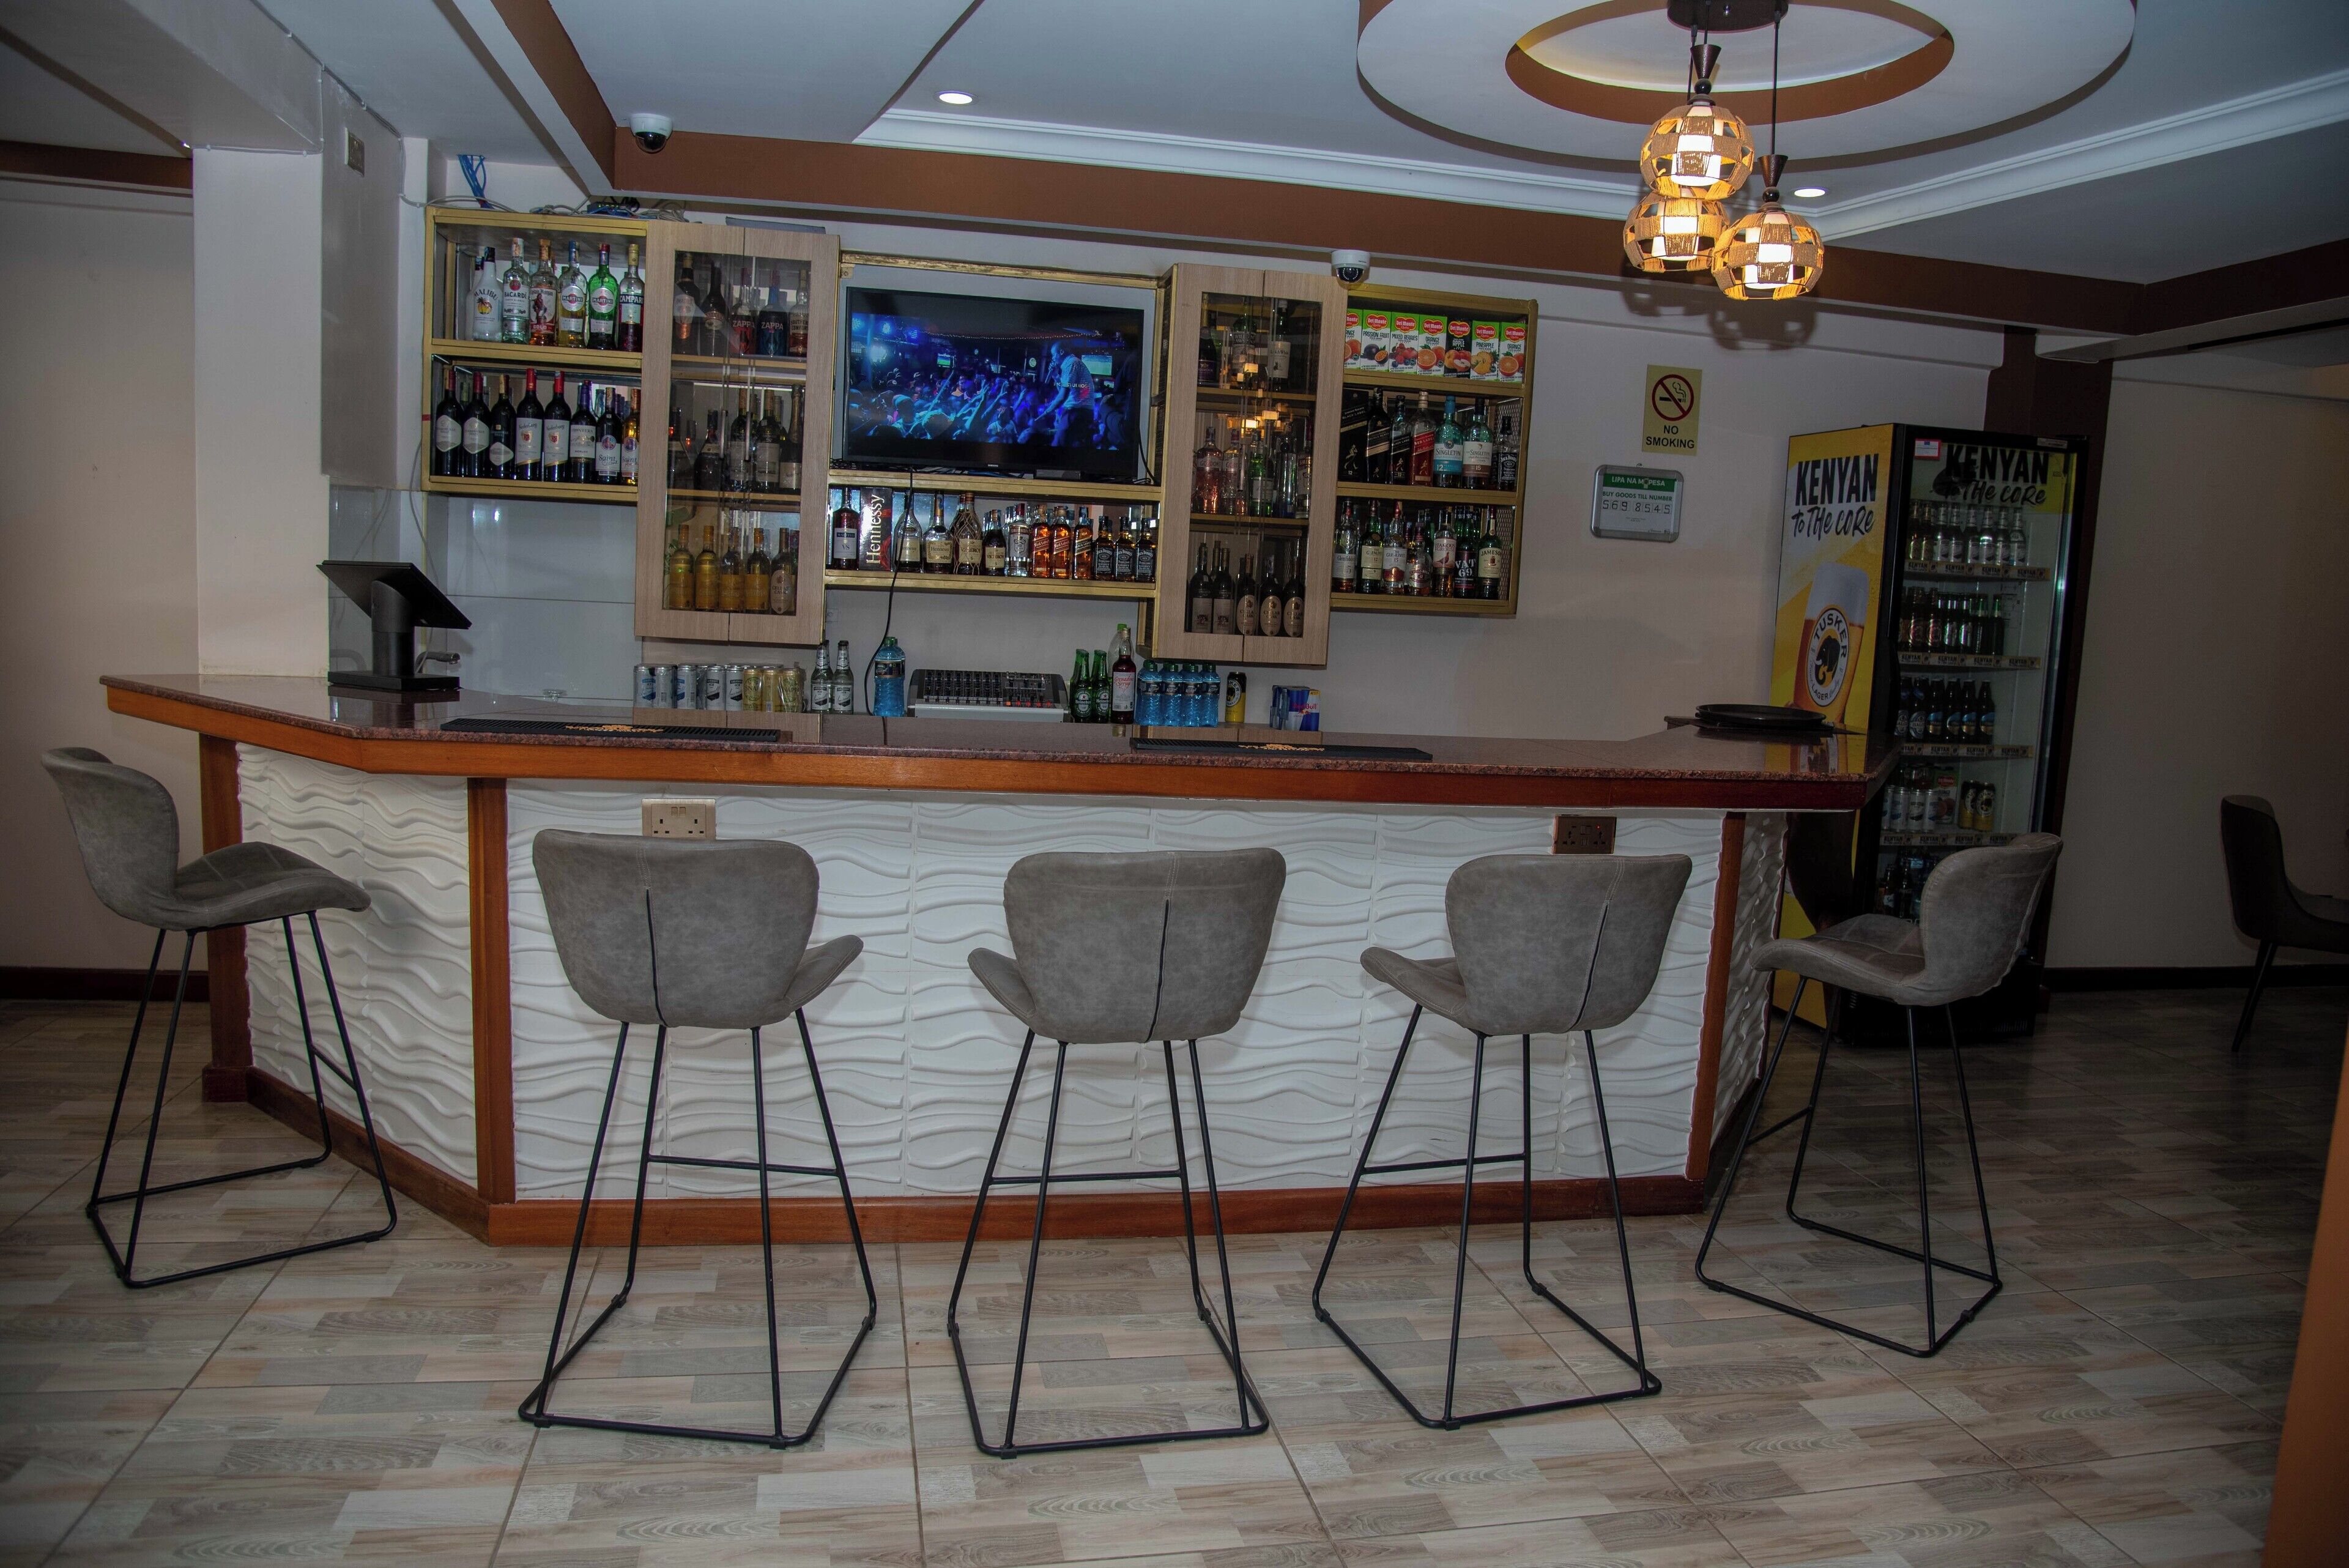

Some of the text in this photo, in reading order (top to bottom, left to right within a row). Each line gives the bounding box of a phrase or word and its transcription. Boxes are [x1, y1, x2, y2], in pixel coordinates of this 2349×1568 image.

[474, 288, 498, 300] MALIBU
[1663, 425, 1679, 434] NO
[1646, 437, 1694, 448] SMOKING
[1946, 444, 2049, 484] KENYAN
[1795, 453, 1879, 506] KENYAN
[866, 494, 885, 563] Hennessy
[1455, 559, 1476, 568] VAT
[1814, 614, 1847, 658] TUSKER
[1228, 680, 1239, 692] SKER
[1811, 683, 1828, 700] LAGER
